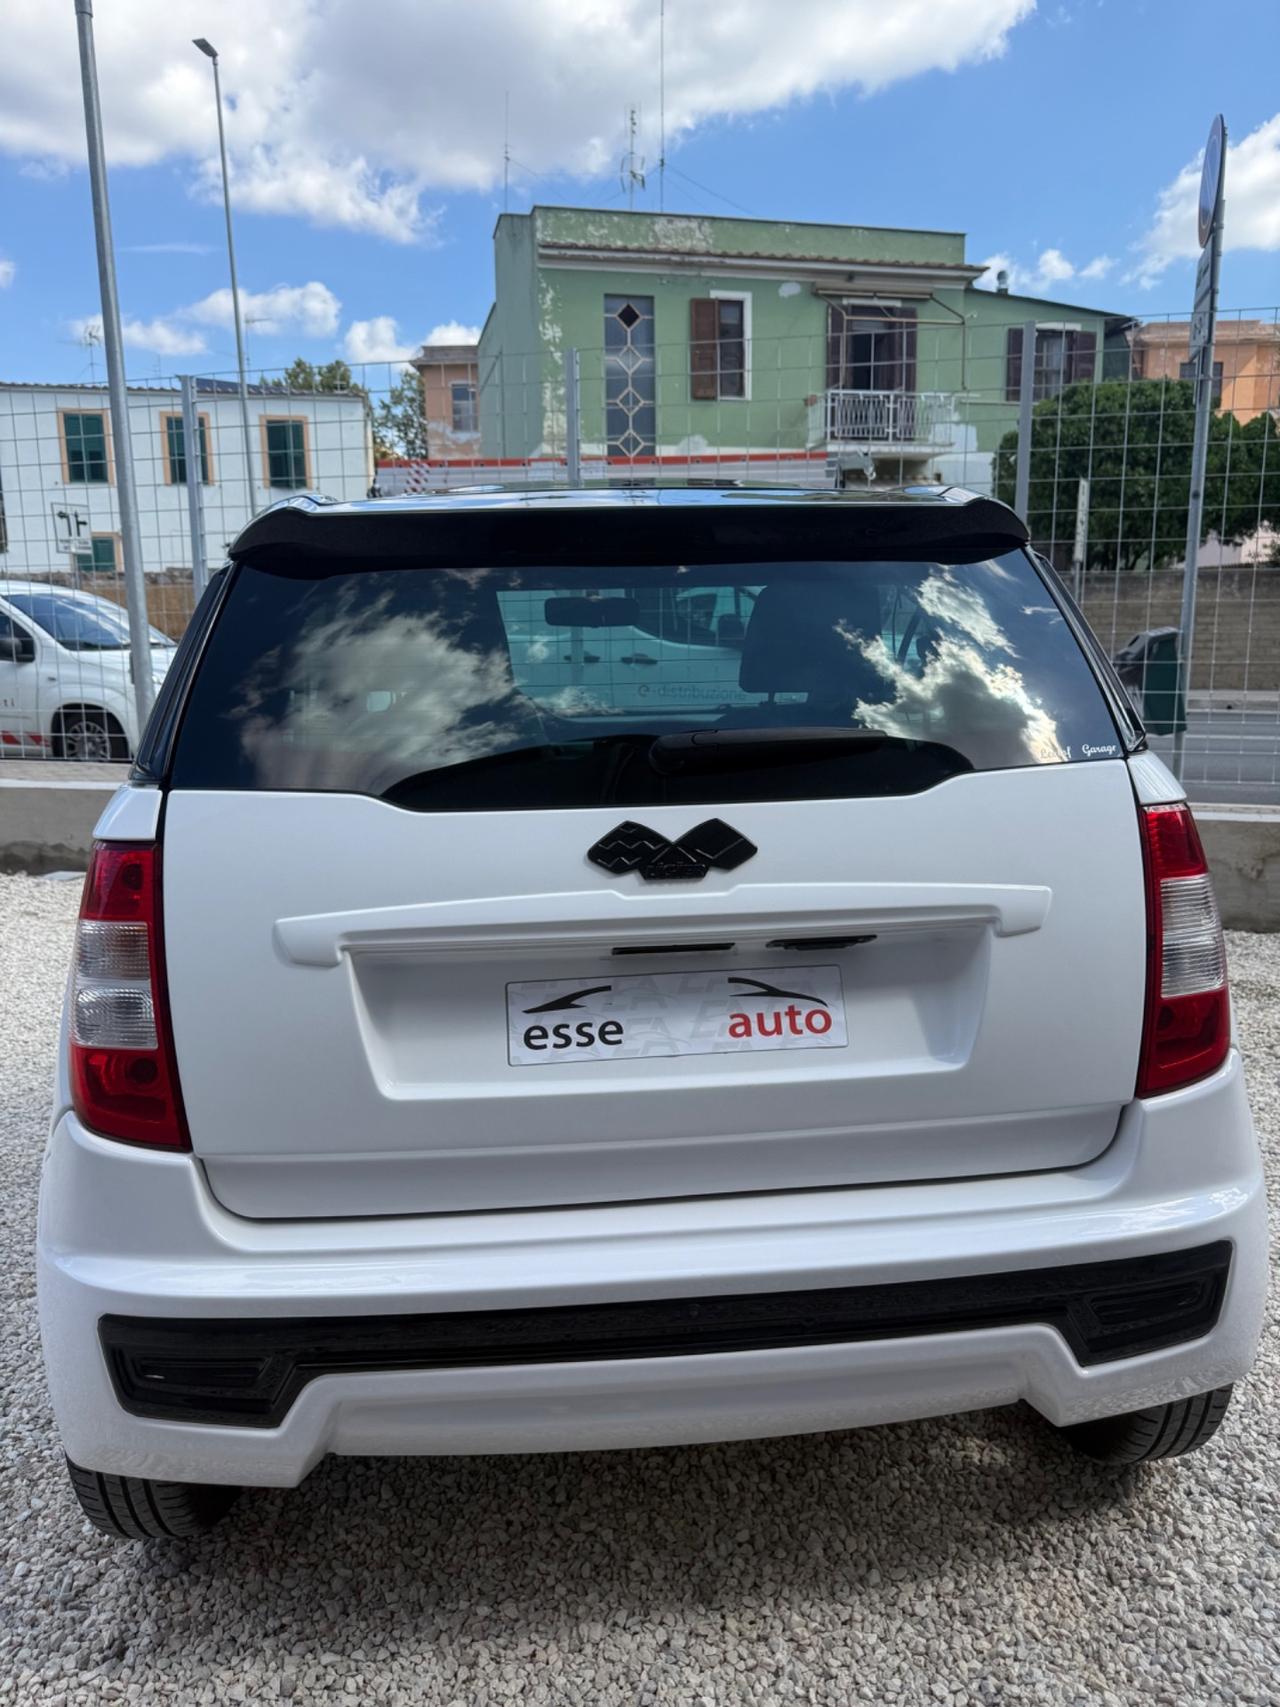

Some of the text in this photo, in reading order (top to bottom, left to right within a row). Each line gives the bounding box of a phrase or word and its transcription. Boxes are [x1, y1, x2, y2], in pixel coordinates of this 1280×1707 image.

[1081, 743, 1117, 757] Garage
[523, 1020, 624, 1050] esse
[728, 1004, 832, 1038] auto
